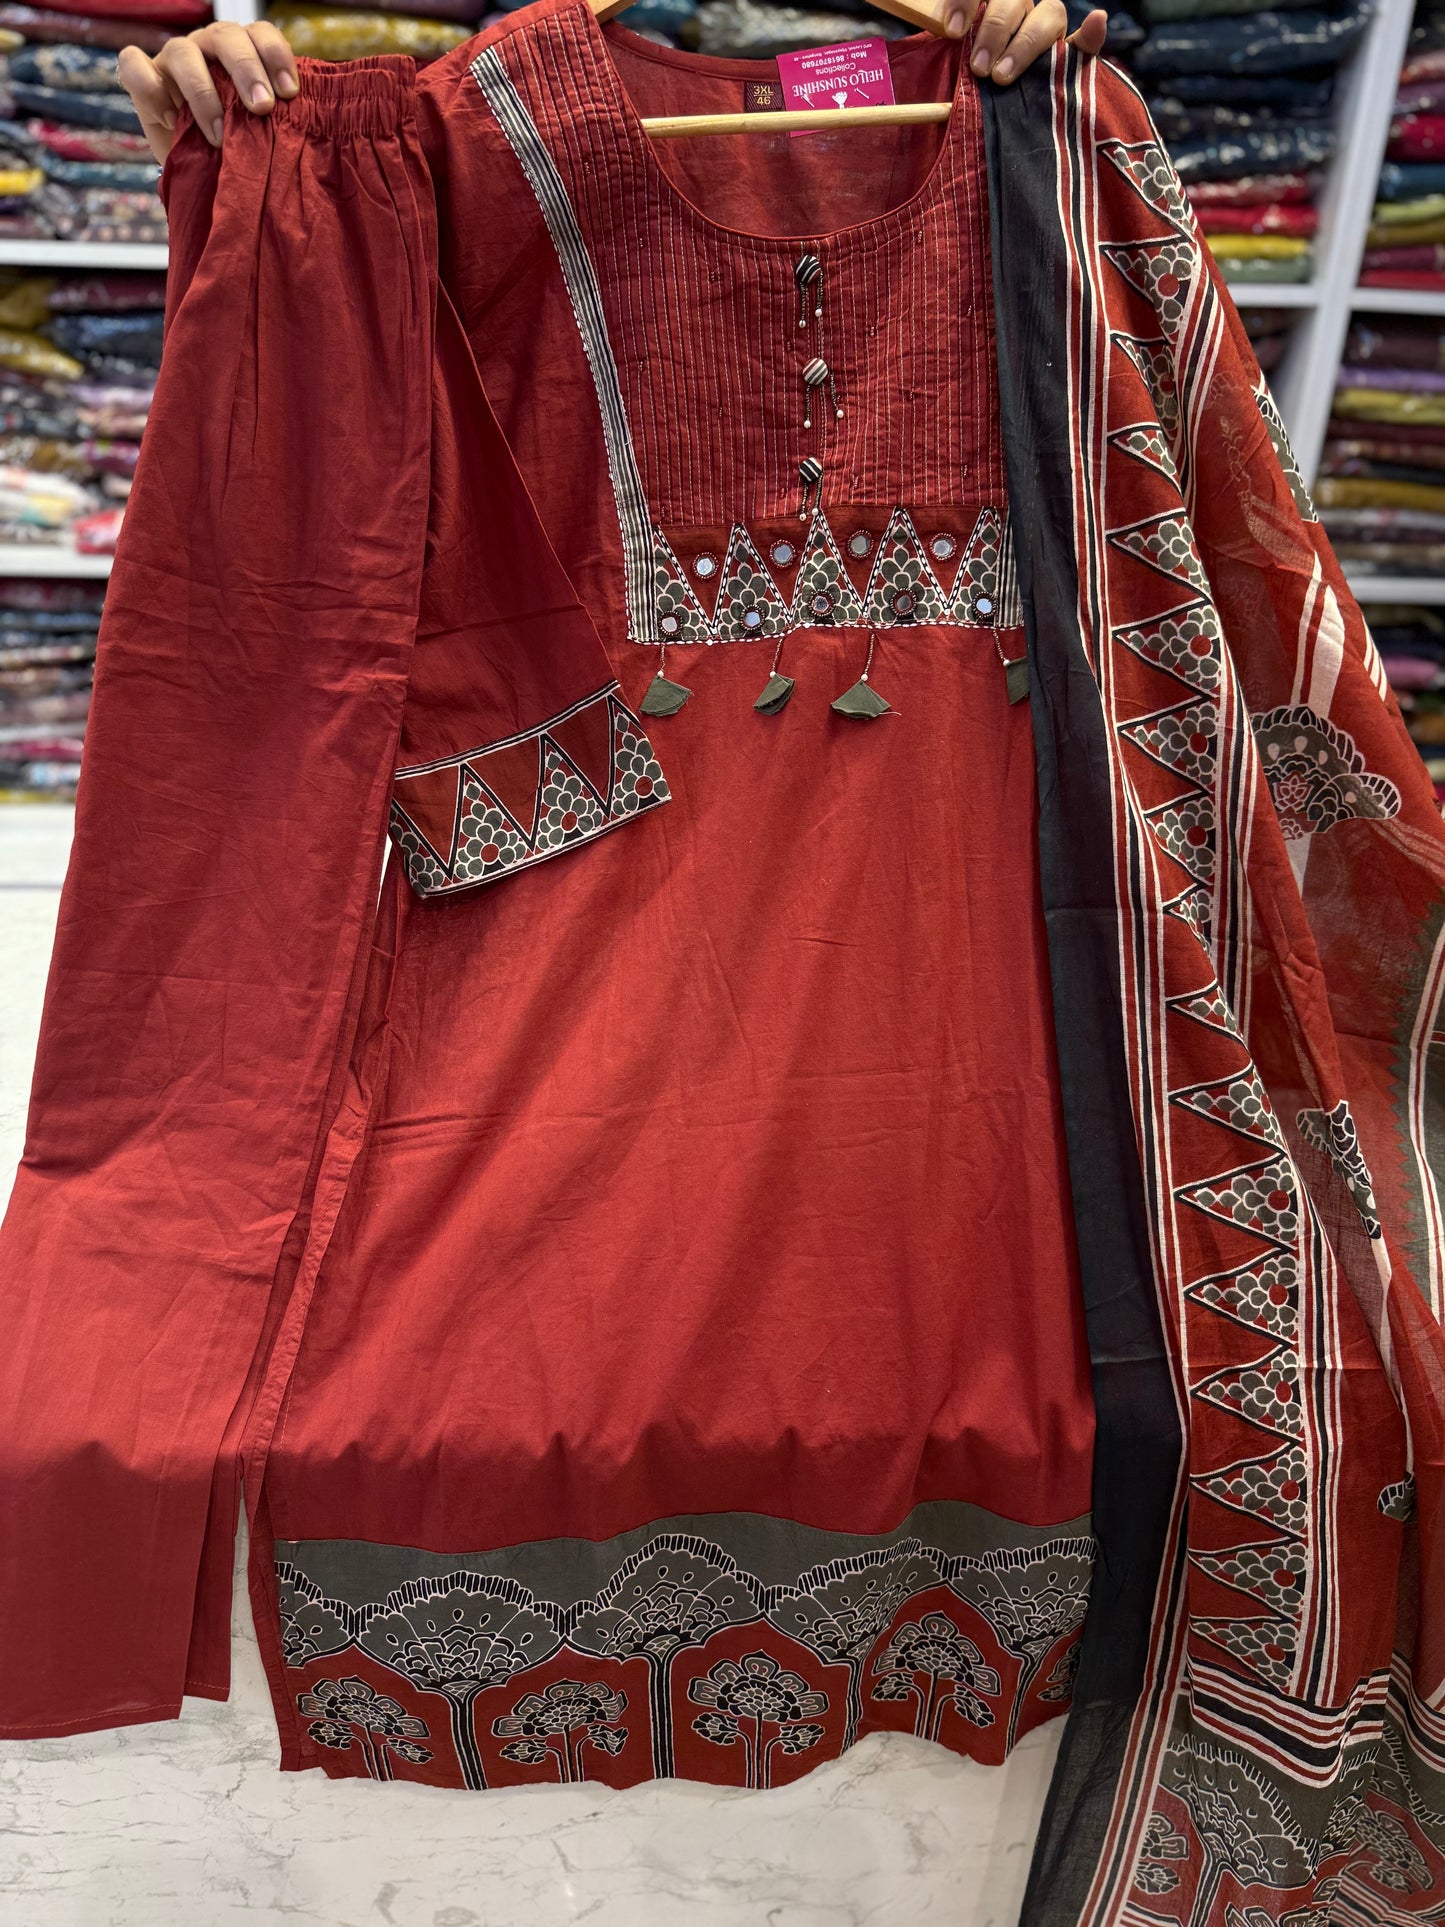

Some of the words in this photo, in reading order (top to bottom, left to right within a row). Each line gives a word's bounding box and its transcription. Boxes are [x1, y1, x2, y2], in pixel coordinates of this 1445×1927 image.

[801, 55, 845, 69] 8618707680
[815, 62, 856, 75] Collections
[849, 69, 884, 86] HELLO
[753, 85, 774, 95] 3XL
[792, 76, 848, 97] SUNSHINE
[756, 96, 771, 105] 46
